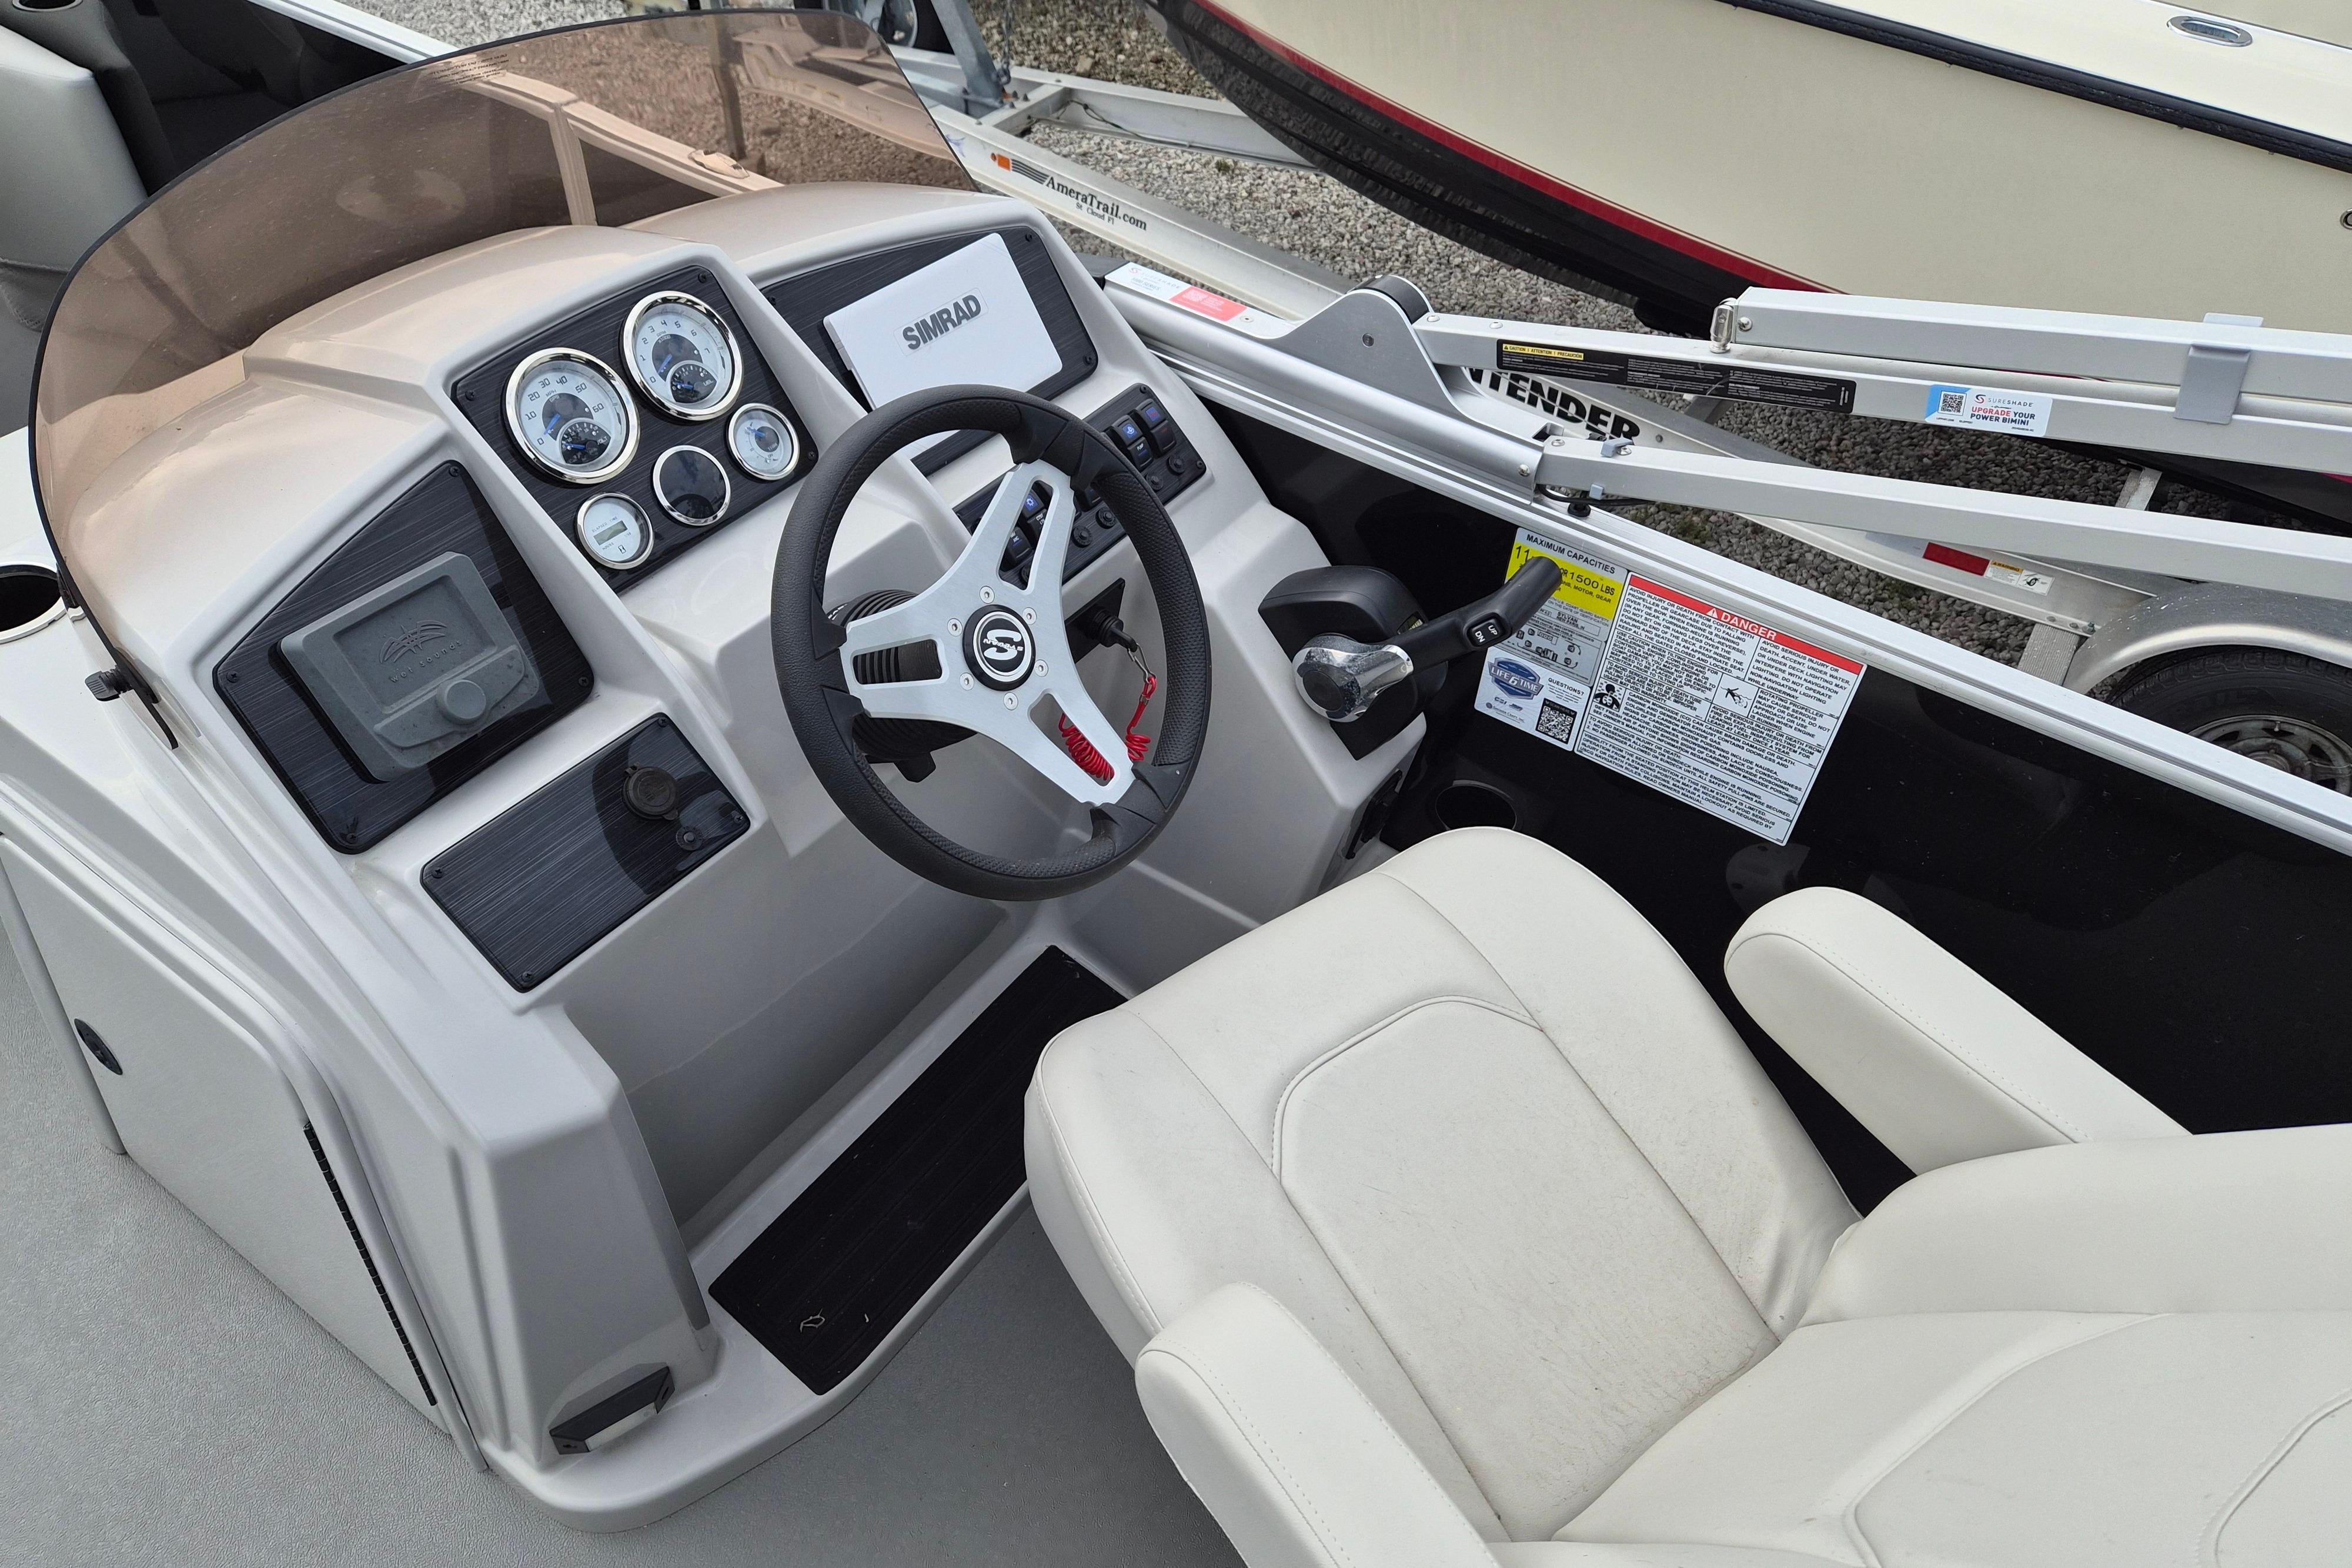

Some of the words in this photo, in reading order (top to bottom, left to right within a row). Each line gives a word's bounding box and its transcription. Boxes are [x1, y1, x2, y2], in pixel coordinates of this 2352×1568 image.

[1046, 176, 1147, 230] AmeraTrail.com
[903, 295, 981, 350] SIMRAD
[538, 378, 550, 389] 30
[556, 376, 567, 385] 40
[575, 383, 587, 393] 50
[528, 392, 540, 401] 20
[1988, 397, 2033, 407] SURESHADE
[525, 411, 536, 420] 10
[593, 403, 604, 413] 60
[1972, 406, 2012, 417] UPGRADE
[2013, 411, 2036, 420] YOUR
[1970, 413, 2000, 423] POWER
[2002, 417, 2029, 426] BIMINI
[1526, 534, 1565, 554] MAXIMUM
[1567, 550, 1615, 574] CAPACITIES
[1570, 571, 1599, 587] 1500
[1601, 584, 1615, 596] LBS
[1573, 585, 1594, 597] MOTOR,
[1596, 594, 1611, 603] GEAR
[1488, 625, 1498, 635] UP
[1720, 612, 1777, 641] DANGER
[1475, 631, 1485, 643] DN
[419, 640, 462, 667] sounds
[1762, 639, 1780, 650] AVOID
[1780, 647, 1807, 660] SERIOUS
[1807, 657, 1829, 669] INJURY
[1491, 666, 1511, 679] LIFE
[1520, 680, 1539, 693] TIME
[1754, 658, 1787, 674] INTERFERE
[1786, 671, 1803, 680] WITH
[1803, 677, 1839, 695] NAVIGATION
[1766, 656, 1788, 667] UNDER
[1788, 664, 1805, 674] DECK
[1805, 671, 1833, 686] LIGHTING
[1833, 683, 1847, 691] MAY
[1806, 664, 1828, 676] UNDER
[1548, 677, 1584, 696] QUESTIONS?
[1747, 676, 1766, 687] WHILE
[1749, 670, 1798, 693] NON-NAVIGATION
[1799, 690, 1826, 704] LIGHTING
[1790, 680, 1804, 688] NOT
[1804, 685, 1832, 699] OPERATE
[1755, 699, 1776, 711] INJURY
[1757, 694, 1770, 703] MAY
[1770, 700, 1790, 711] CAUSE
[1790, 708, 1817, 721] SERIOUS
[1759, 689, 1789, 704] ROTATING
[1788, 701, 1824, 718] PROPELLER
[1751, 709, 1775, 721] LADDER
[1775, 719, 1793, 729] WHEN
[1793, 727, 1815, 738] ENGINE
[1753, 704, 1786, 720] APPROACH
[1795, 721, 1808, 730] USE
